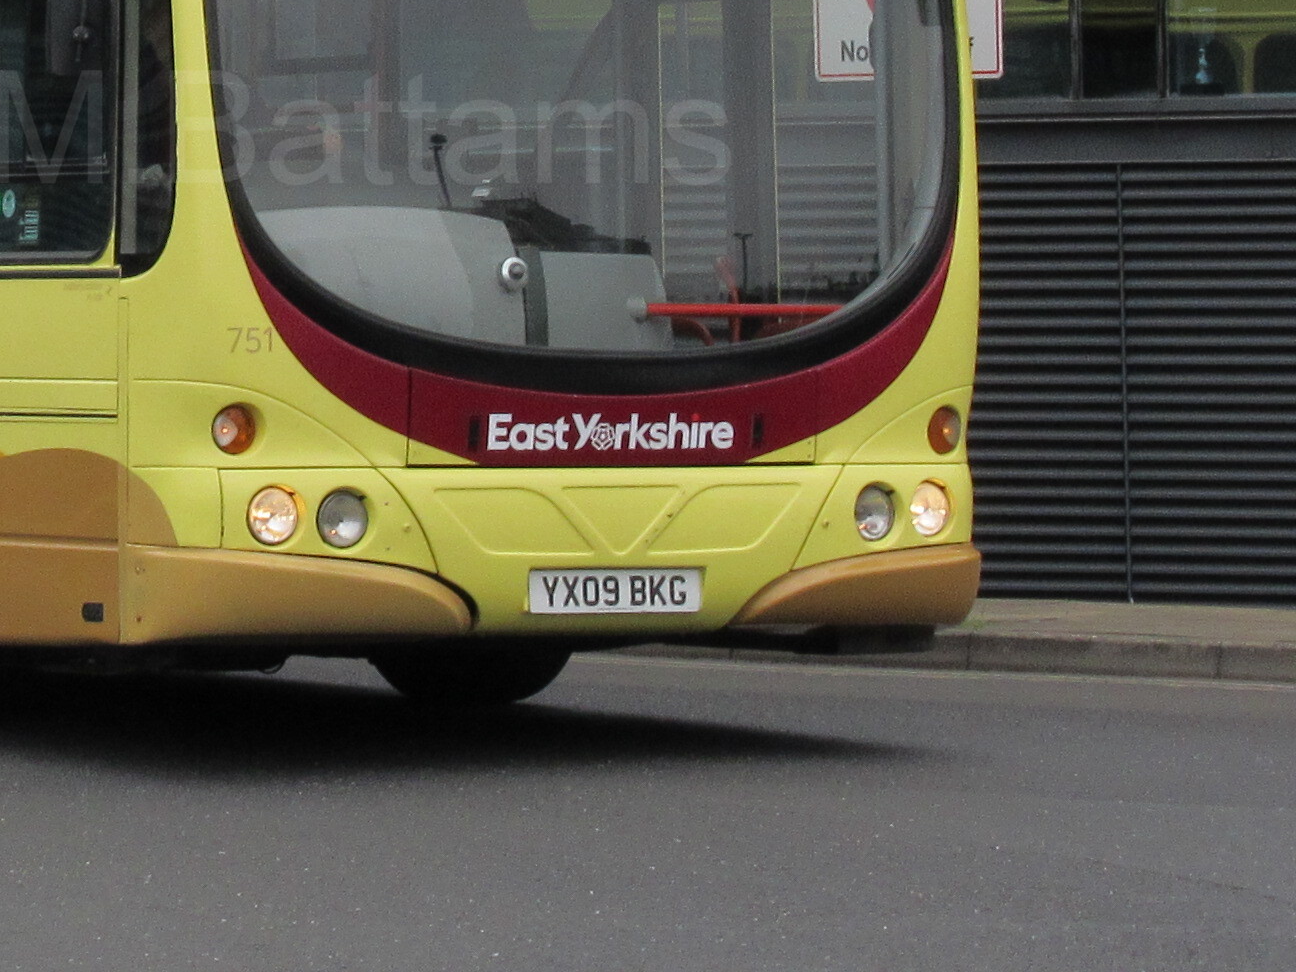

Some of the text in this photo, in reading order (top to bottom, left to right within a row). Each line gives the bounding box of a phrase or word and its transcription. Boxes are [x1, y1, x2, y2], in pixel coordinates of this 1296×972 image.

[226, 326, 273, 354] 751
[541, 575, 687, 607] YX09 BKG
